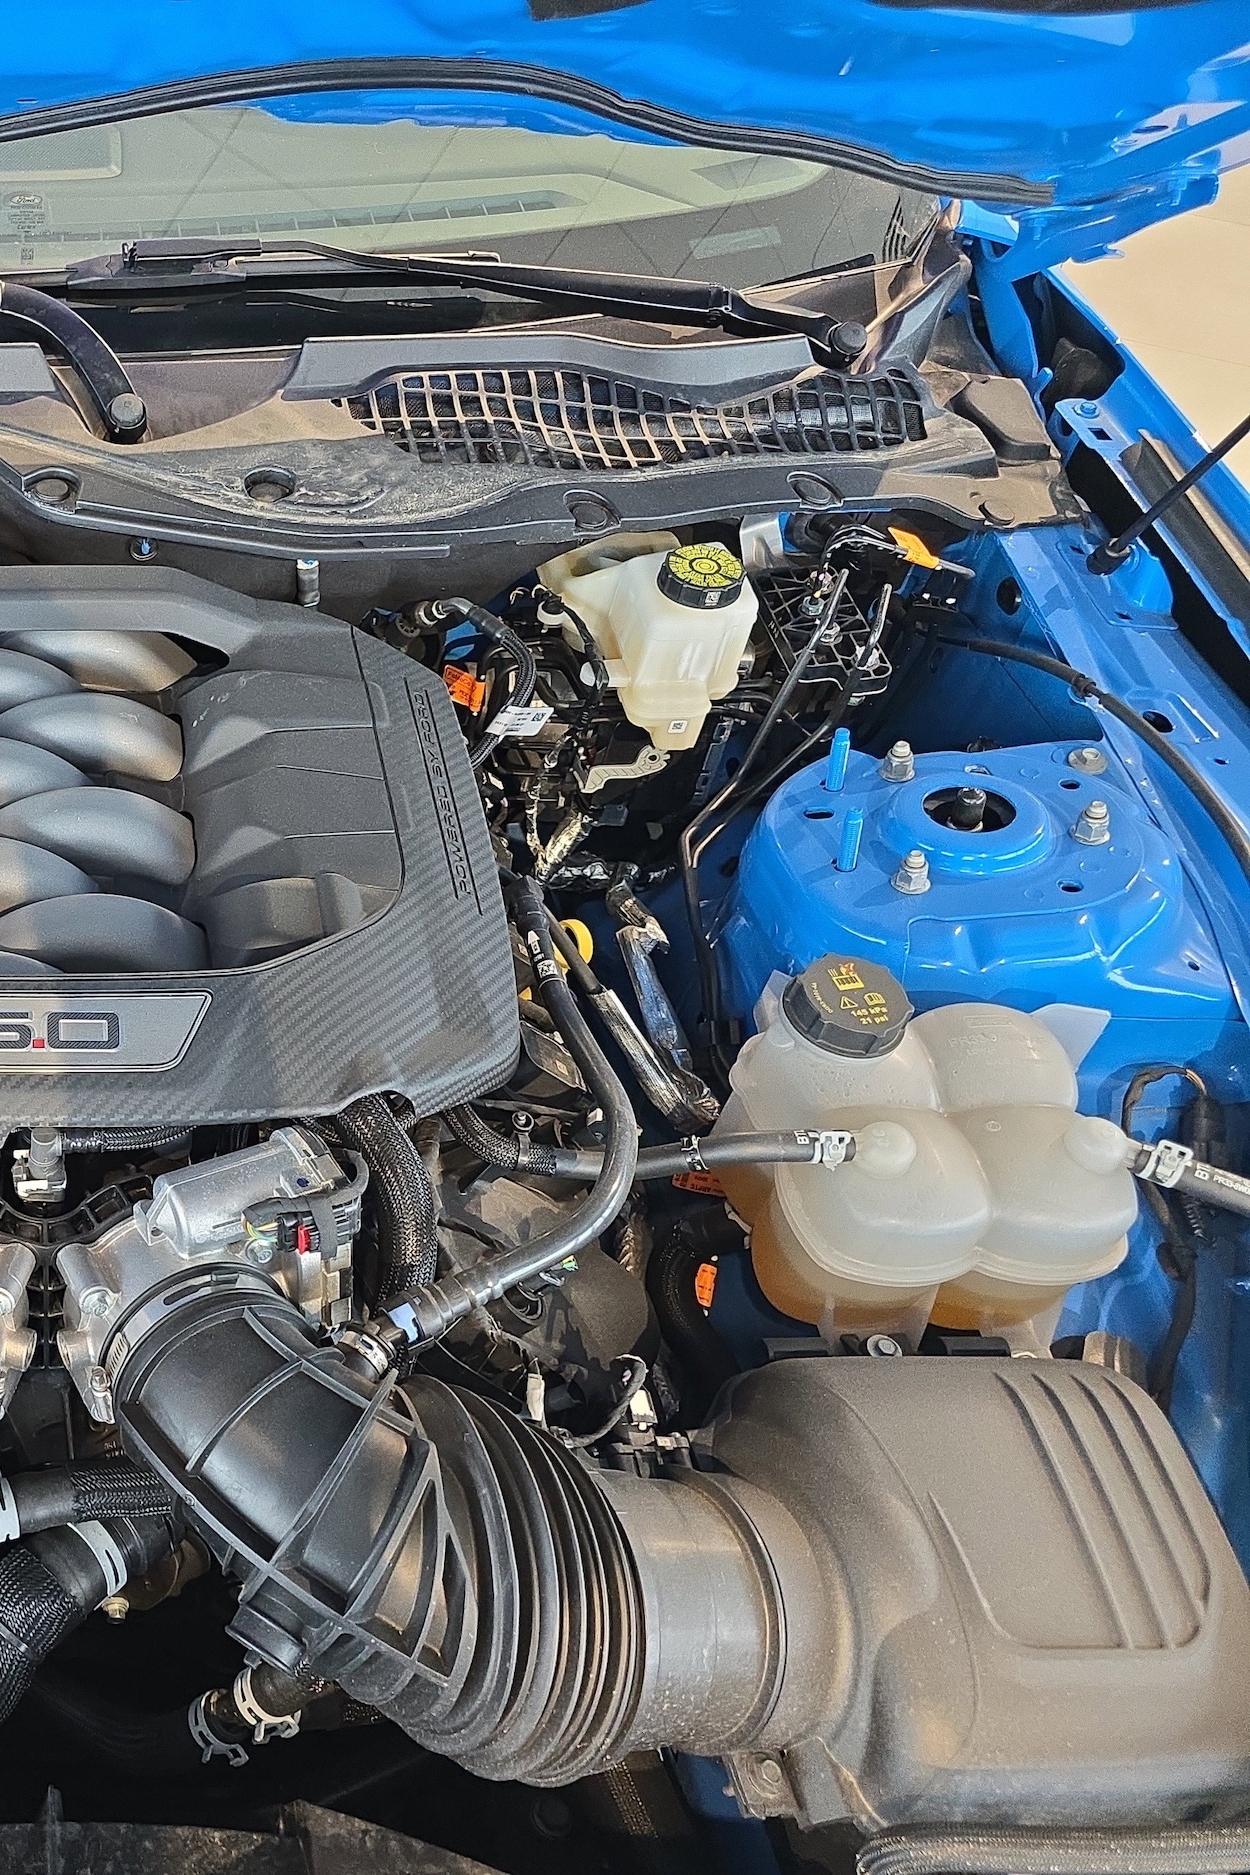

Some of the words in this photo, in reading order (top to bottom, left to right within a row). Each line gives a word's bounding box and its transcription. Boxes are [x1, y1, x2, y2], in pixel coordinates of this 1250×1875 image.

[414, 692, 439, 746] FORD
[433, 784, 472, 895] POWERED
[850, 1008, 868, 1018] 145
[869, 1006, 888, 1016] kPa
[860, 1017, 872, 1025] 21
[874, 1015, 889, 1025] psi
